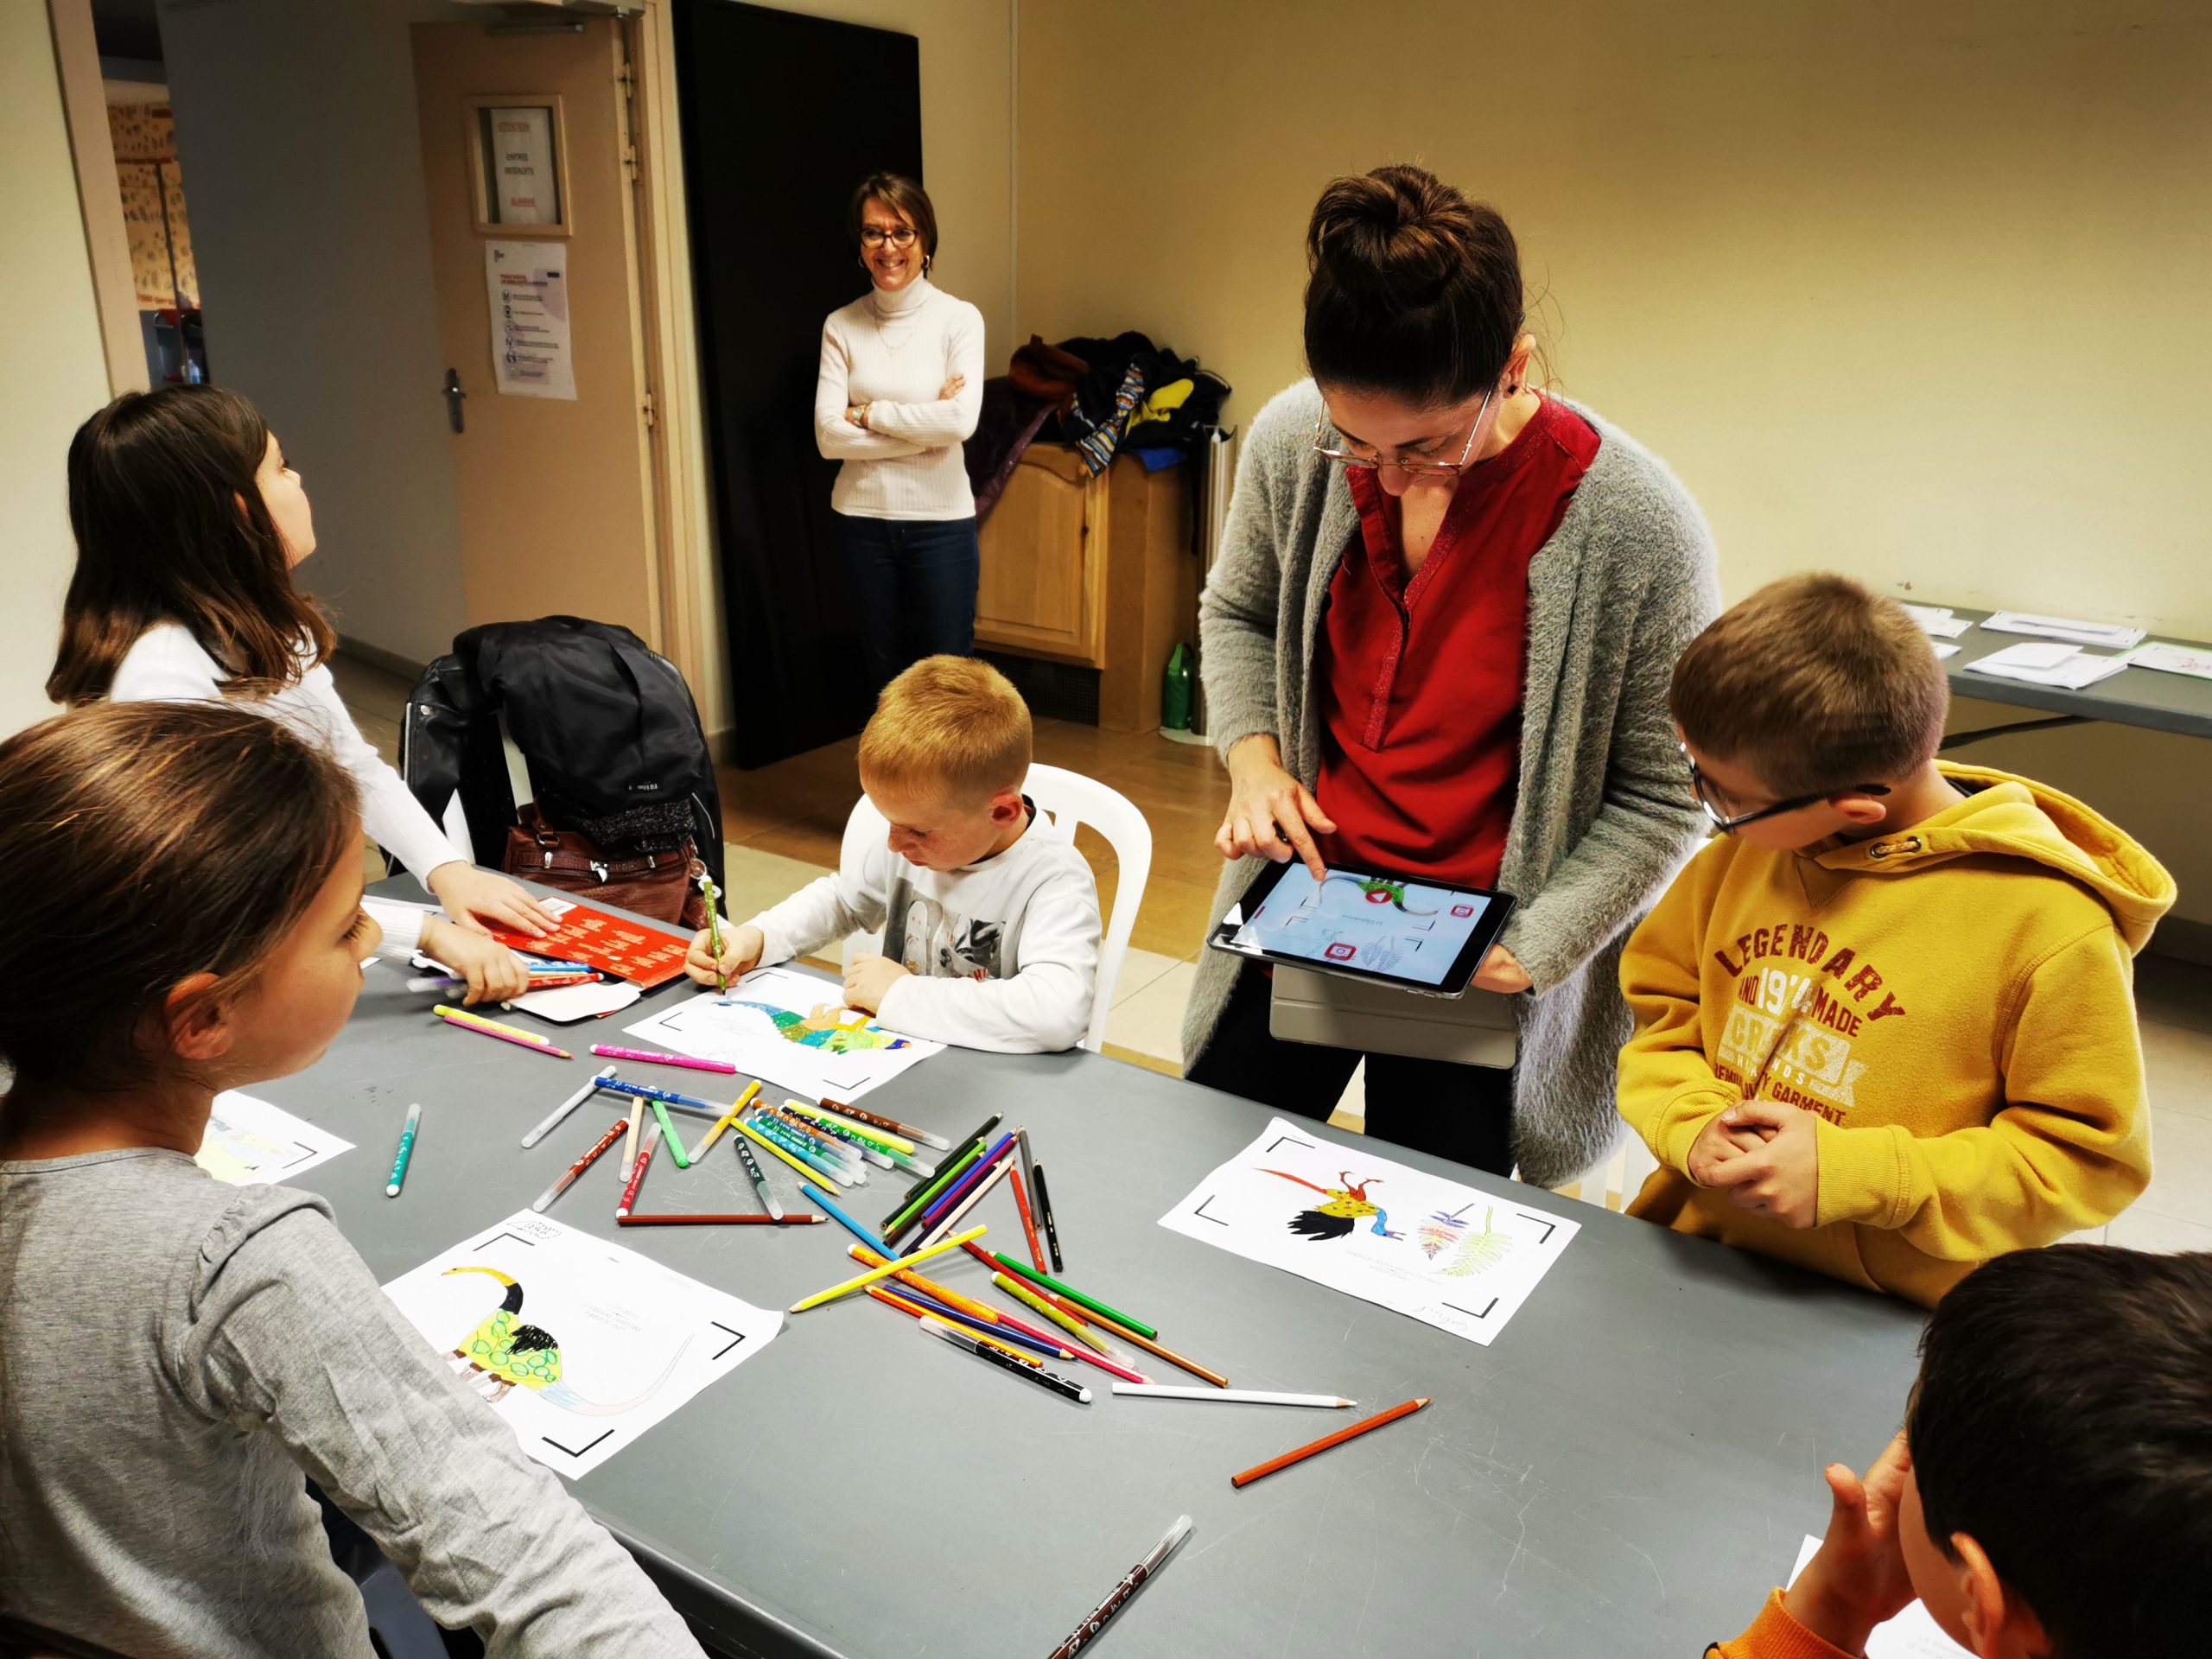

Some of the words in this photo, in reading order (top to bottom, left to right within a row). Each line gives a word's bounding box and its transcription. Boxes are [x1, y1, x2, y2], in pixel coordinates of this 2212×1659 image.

[1714, 924, 1906, 1021] LEGENDARY
[1811, 987, 1862, 1038] MADE
[1771, 1081, 1847, 1127] GARMENT
